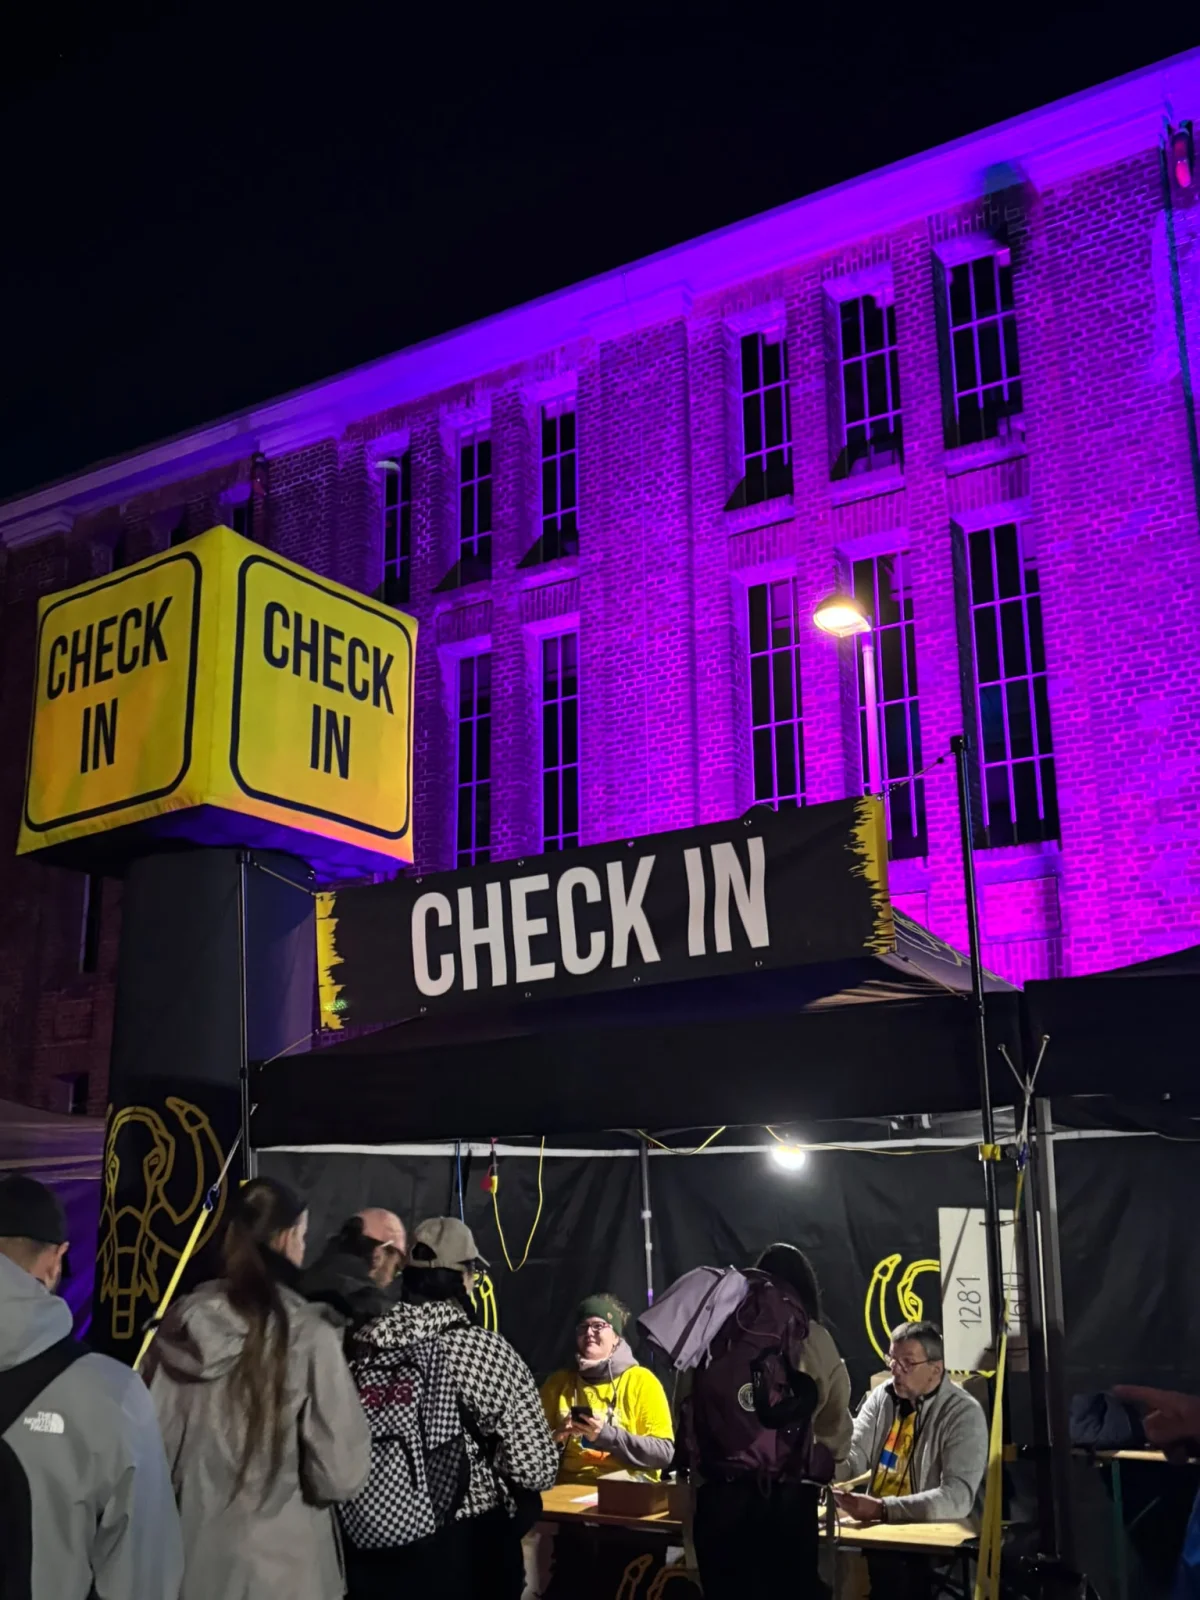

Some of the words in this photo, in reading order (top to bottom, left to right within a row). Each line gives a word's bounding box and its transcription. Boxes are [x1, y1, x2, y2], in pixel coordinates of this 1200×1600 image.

[47, 596, 173, 699] CHECK
[263, 601, 395, 714] CHECK
[80, 698, 118, 774] IN
[310, 704, 351, 780] IN
[411, 855, 660, 997] CHECK
[684, 836, 770, 957] IN
[956, 1277, 981, 1328] 1281
